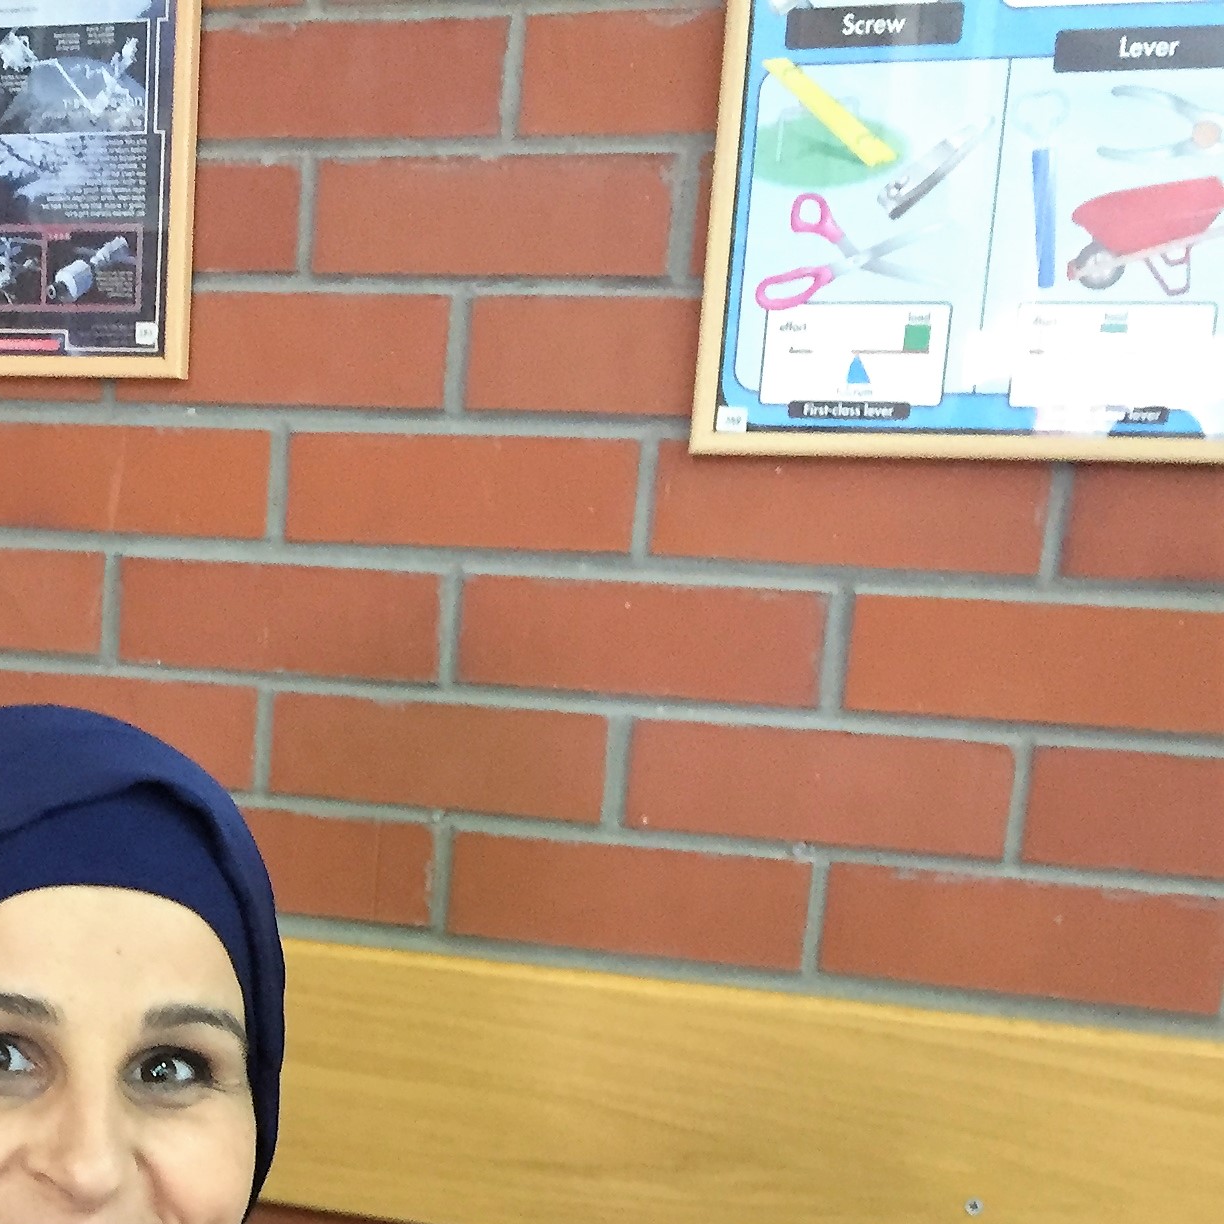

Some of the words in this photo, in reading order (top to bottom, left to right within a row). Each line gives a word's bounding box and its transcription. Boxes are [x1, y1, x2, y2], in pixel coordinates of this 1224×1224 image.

[841, 12, 907, 36] Screw
[1119, 34, 1181, 58] Lever
[779, 321, 807, 332] effort
[802, 402, 861, 417] First-class
[864, 402, 895, 418] lever
